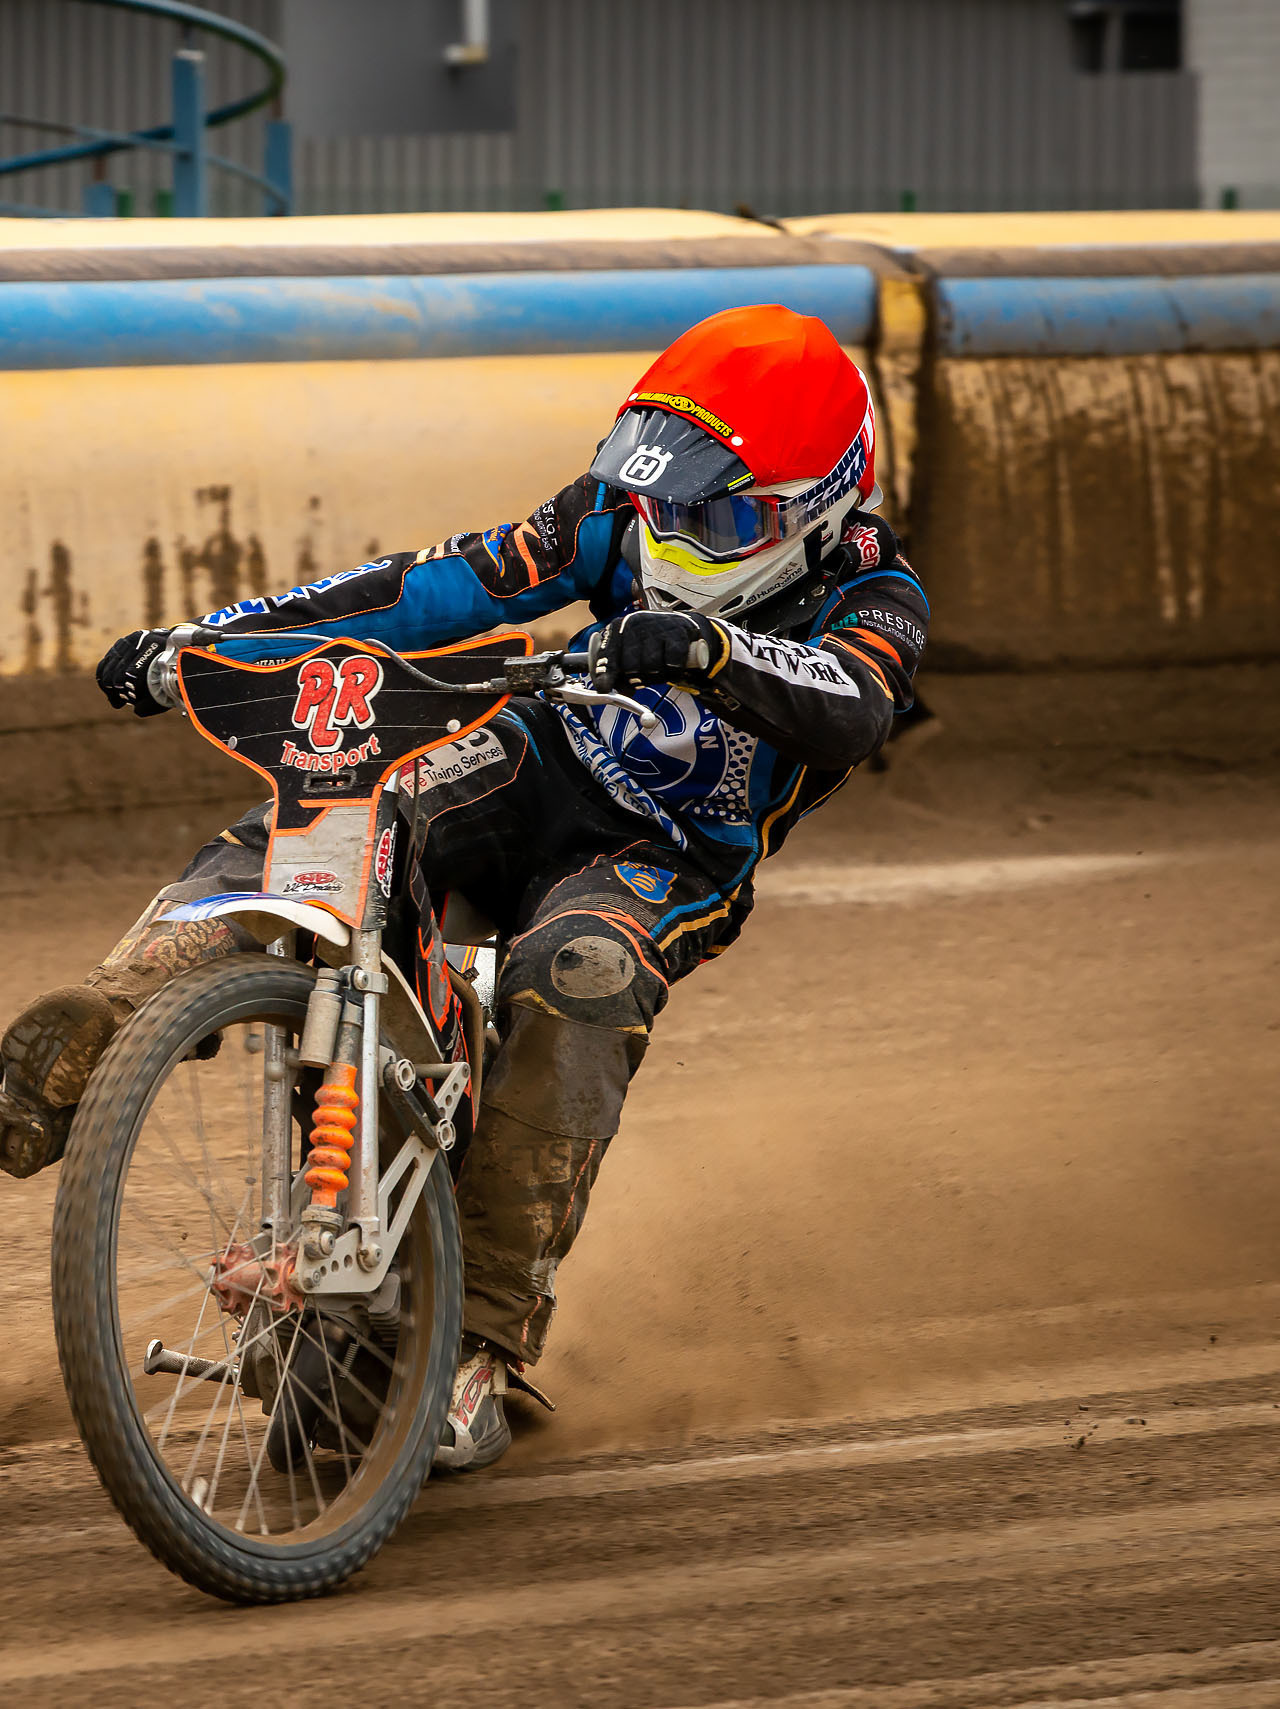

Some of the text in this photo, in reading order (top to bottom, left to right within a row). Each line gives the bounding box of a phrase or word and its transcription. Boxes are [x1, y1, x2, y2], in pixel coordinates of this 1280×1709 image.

[691, 405, 733, 437] PRODUCTS
[858, 609, 926, 650] PRESTIGE
[280, 733, 382, 774] Transport
